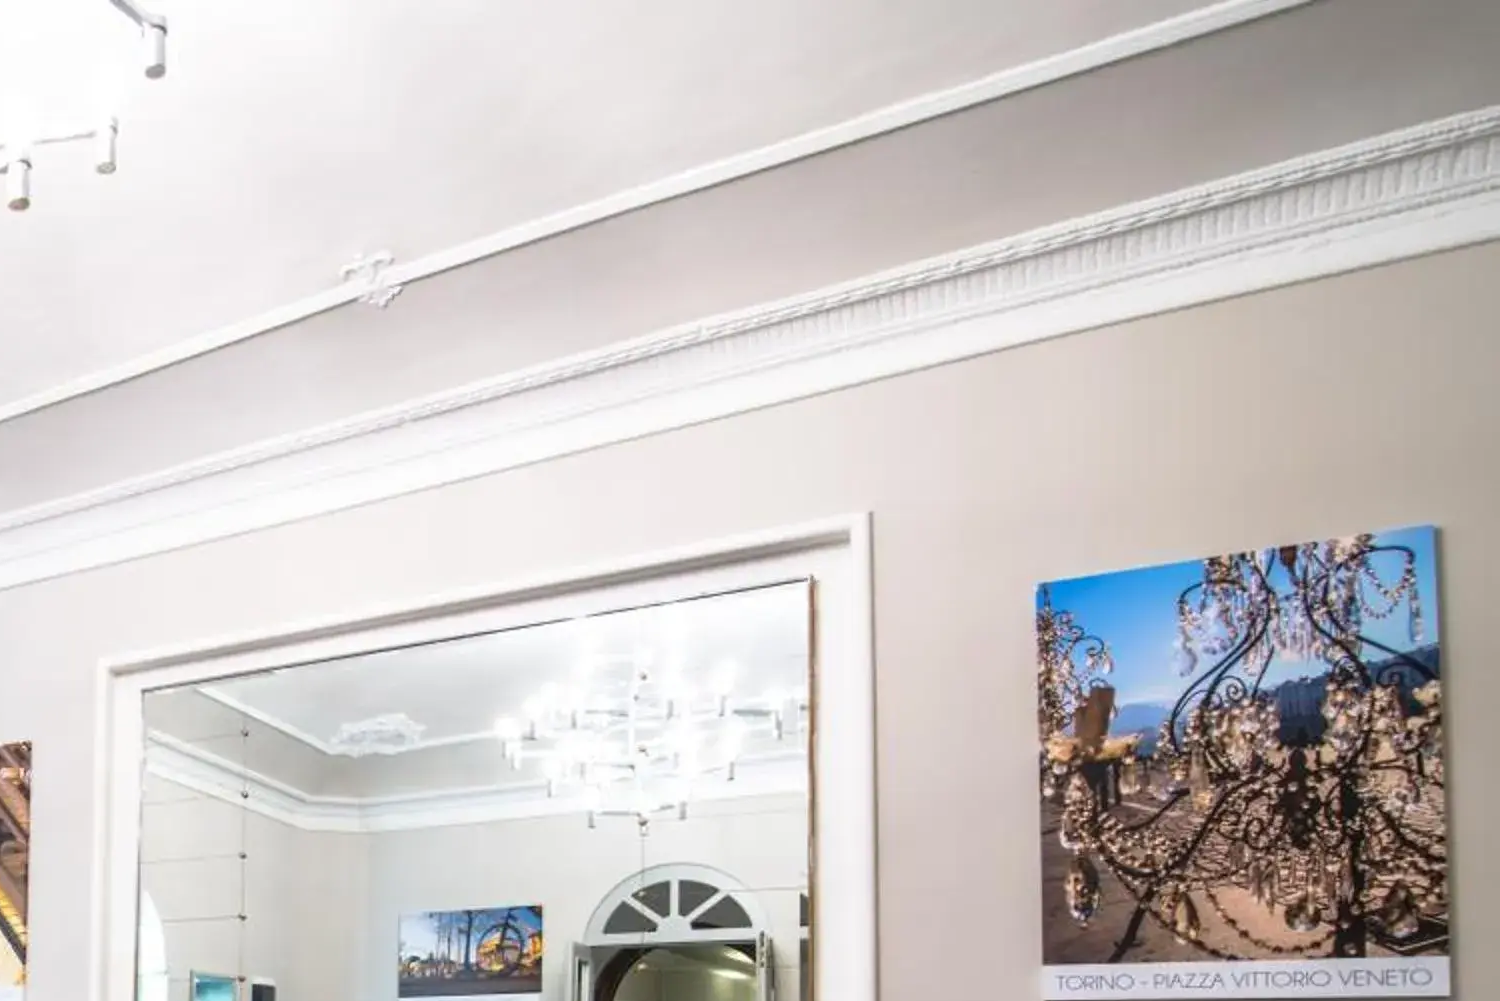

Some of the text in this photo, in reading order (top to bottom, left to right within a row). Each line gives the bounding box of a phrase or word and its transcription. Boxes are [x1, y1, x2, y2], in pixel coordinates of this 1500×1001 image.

[1055, 974, 1135, 992] TORINO
[1153, 972, 1226, 990] PIAZZA
[1231, 969, 1332, 988] VITTORIO
[1338, 967, 1433, 987] VENETO
